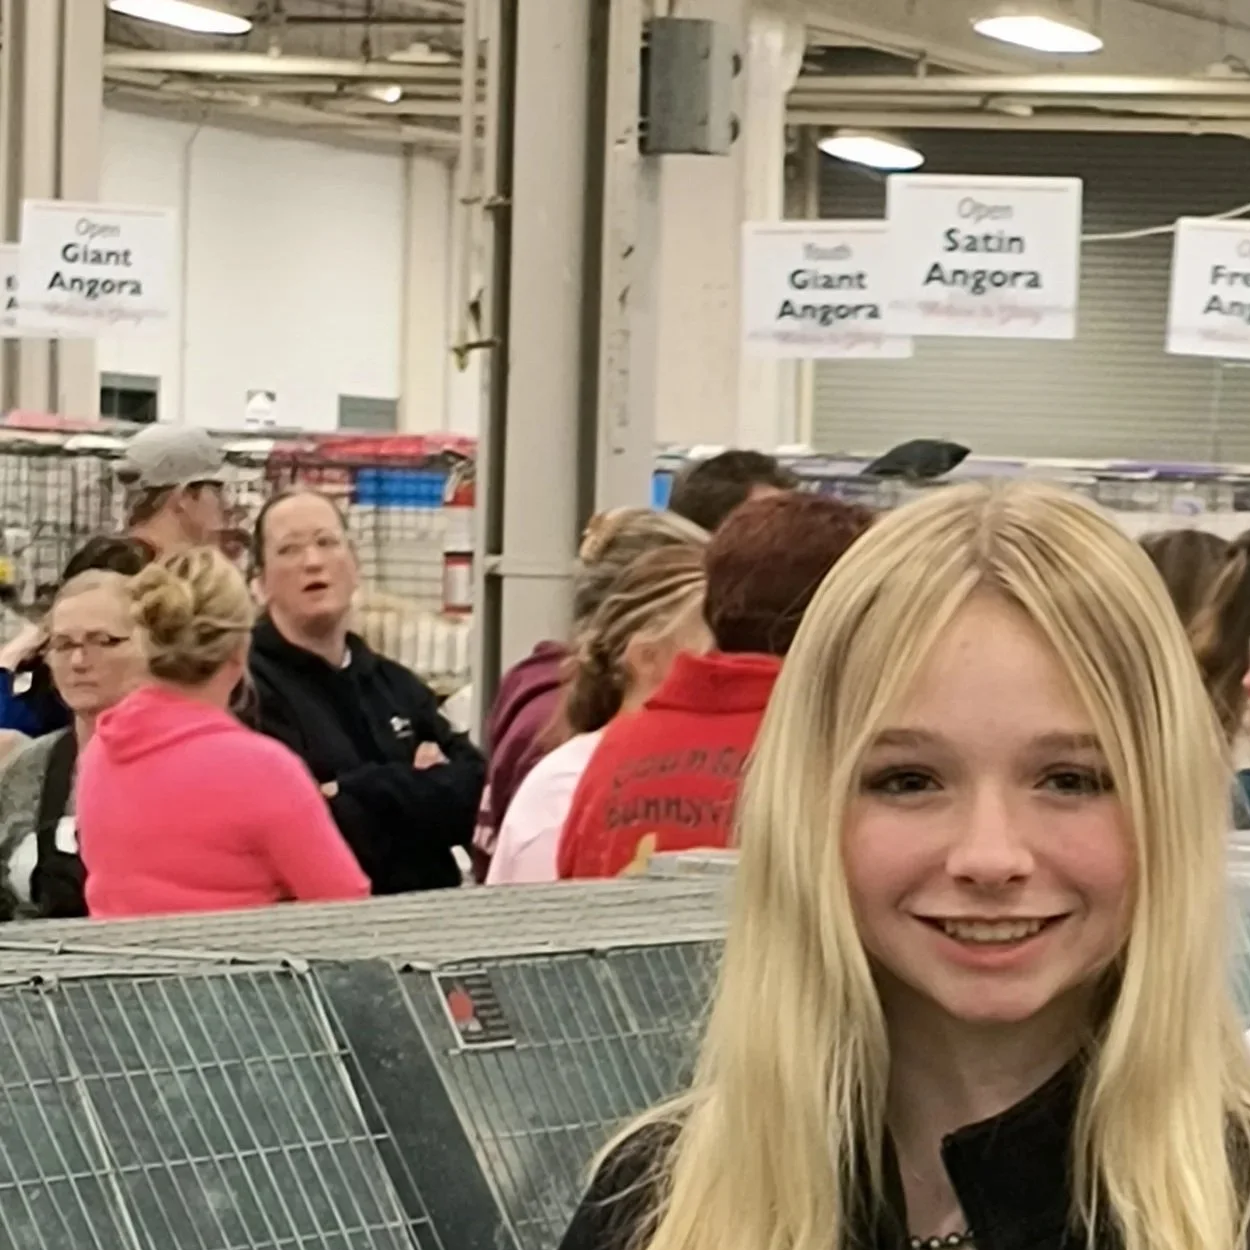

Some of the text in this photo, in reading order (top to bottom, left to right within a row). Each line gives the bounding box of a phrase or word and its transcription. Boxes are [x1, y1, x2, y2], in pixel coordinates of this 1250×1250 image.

[958, 196, 1014, 223] Open
[75, 218, 122, 240] Open
[944, 227, 1025, 253] Satin
[61, 242, 133, 267] Giant
[47, 271, 143, 300] Angora
[789, 268, 867, 290] Giant
[923, 261, 1042, 295] Angora
[777, 299, 881, 327] Angora
